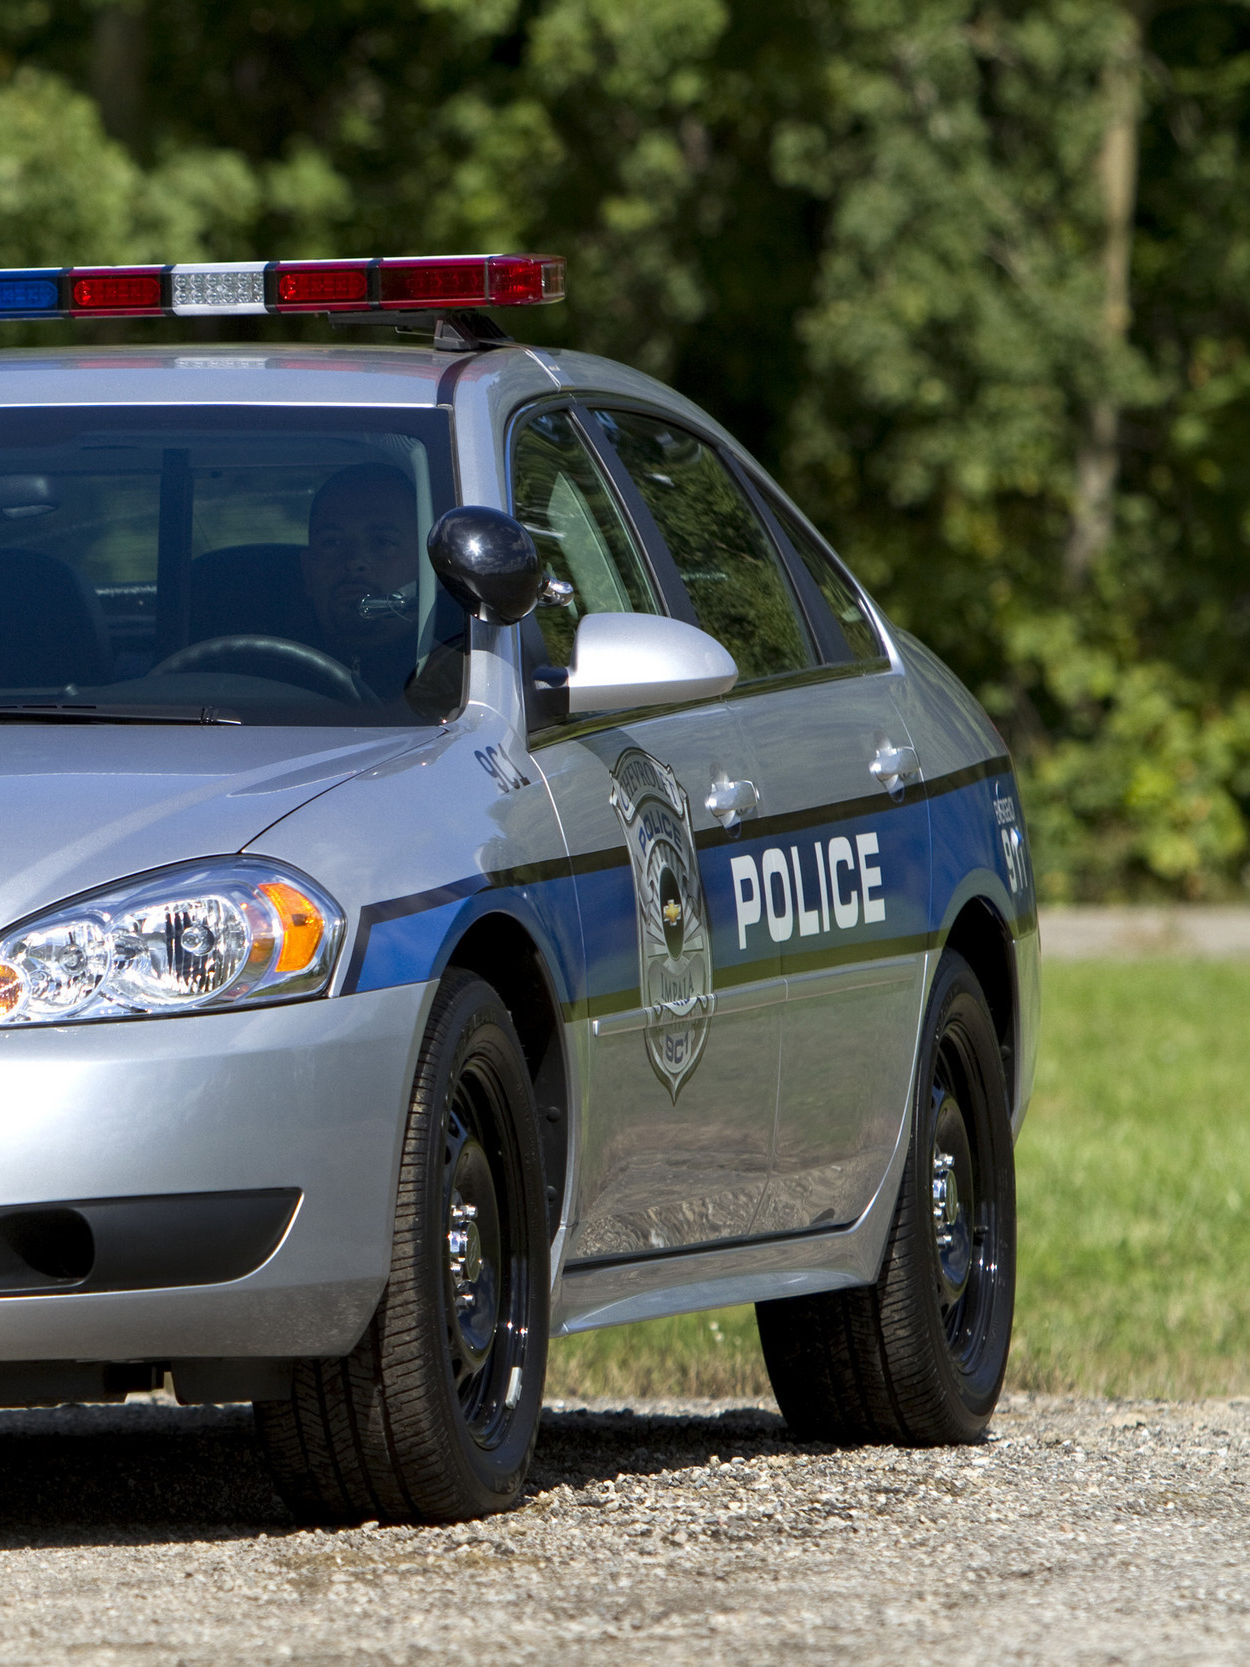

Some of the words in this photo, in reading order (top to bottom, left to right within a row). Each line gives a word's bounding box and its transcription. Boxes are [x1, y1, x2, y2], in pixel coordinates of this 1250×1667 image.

[619, 760, 680, 811] CHEVROLET
[638, 809, 683, 857] POLICE
[730, 832, 886, 950] POLICE
[660, 970, 694, 1005] IMPALA
[665, 1031, 689, 1064] 9C1
